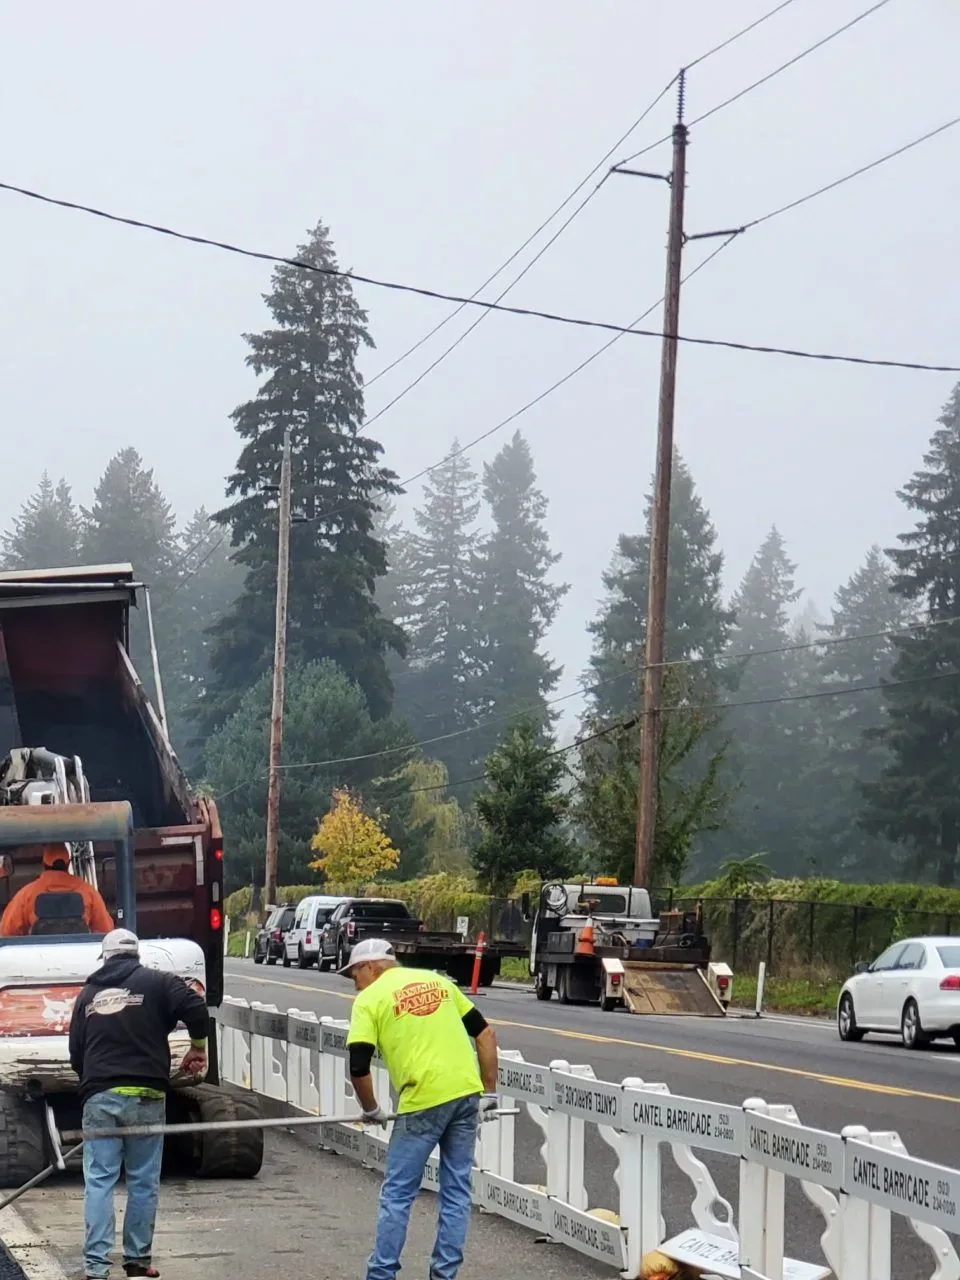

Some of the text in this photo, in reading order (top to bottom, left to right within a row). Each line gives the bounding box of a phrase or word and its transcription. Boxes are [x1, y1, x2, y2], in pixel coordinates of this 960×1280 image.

[393, 989, 449, 1018] PAVING
[593, 1092, 617, 1116] CANTEL
[632, 1102, 712, 1136] CANTEL BARRICADE
[749, 1125, 810, 1168] CANTEL BARRICADE
[852, 1156, 930, 1208] CANTEL BARRICADE
[678, 1237, 719, 1261] CANTEL
